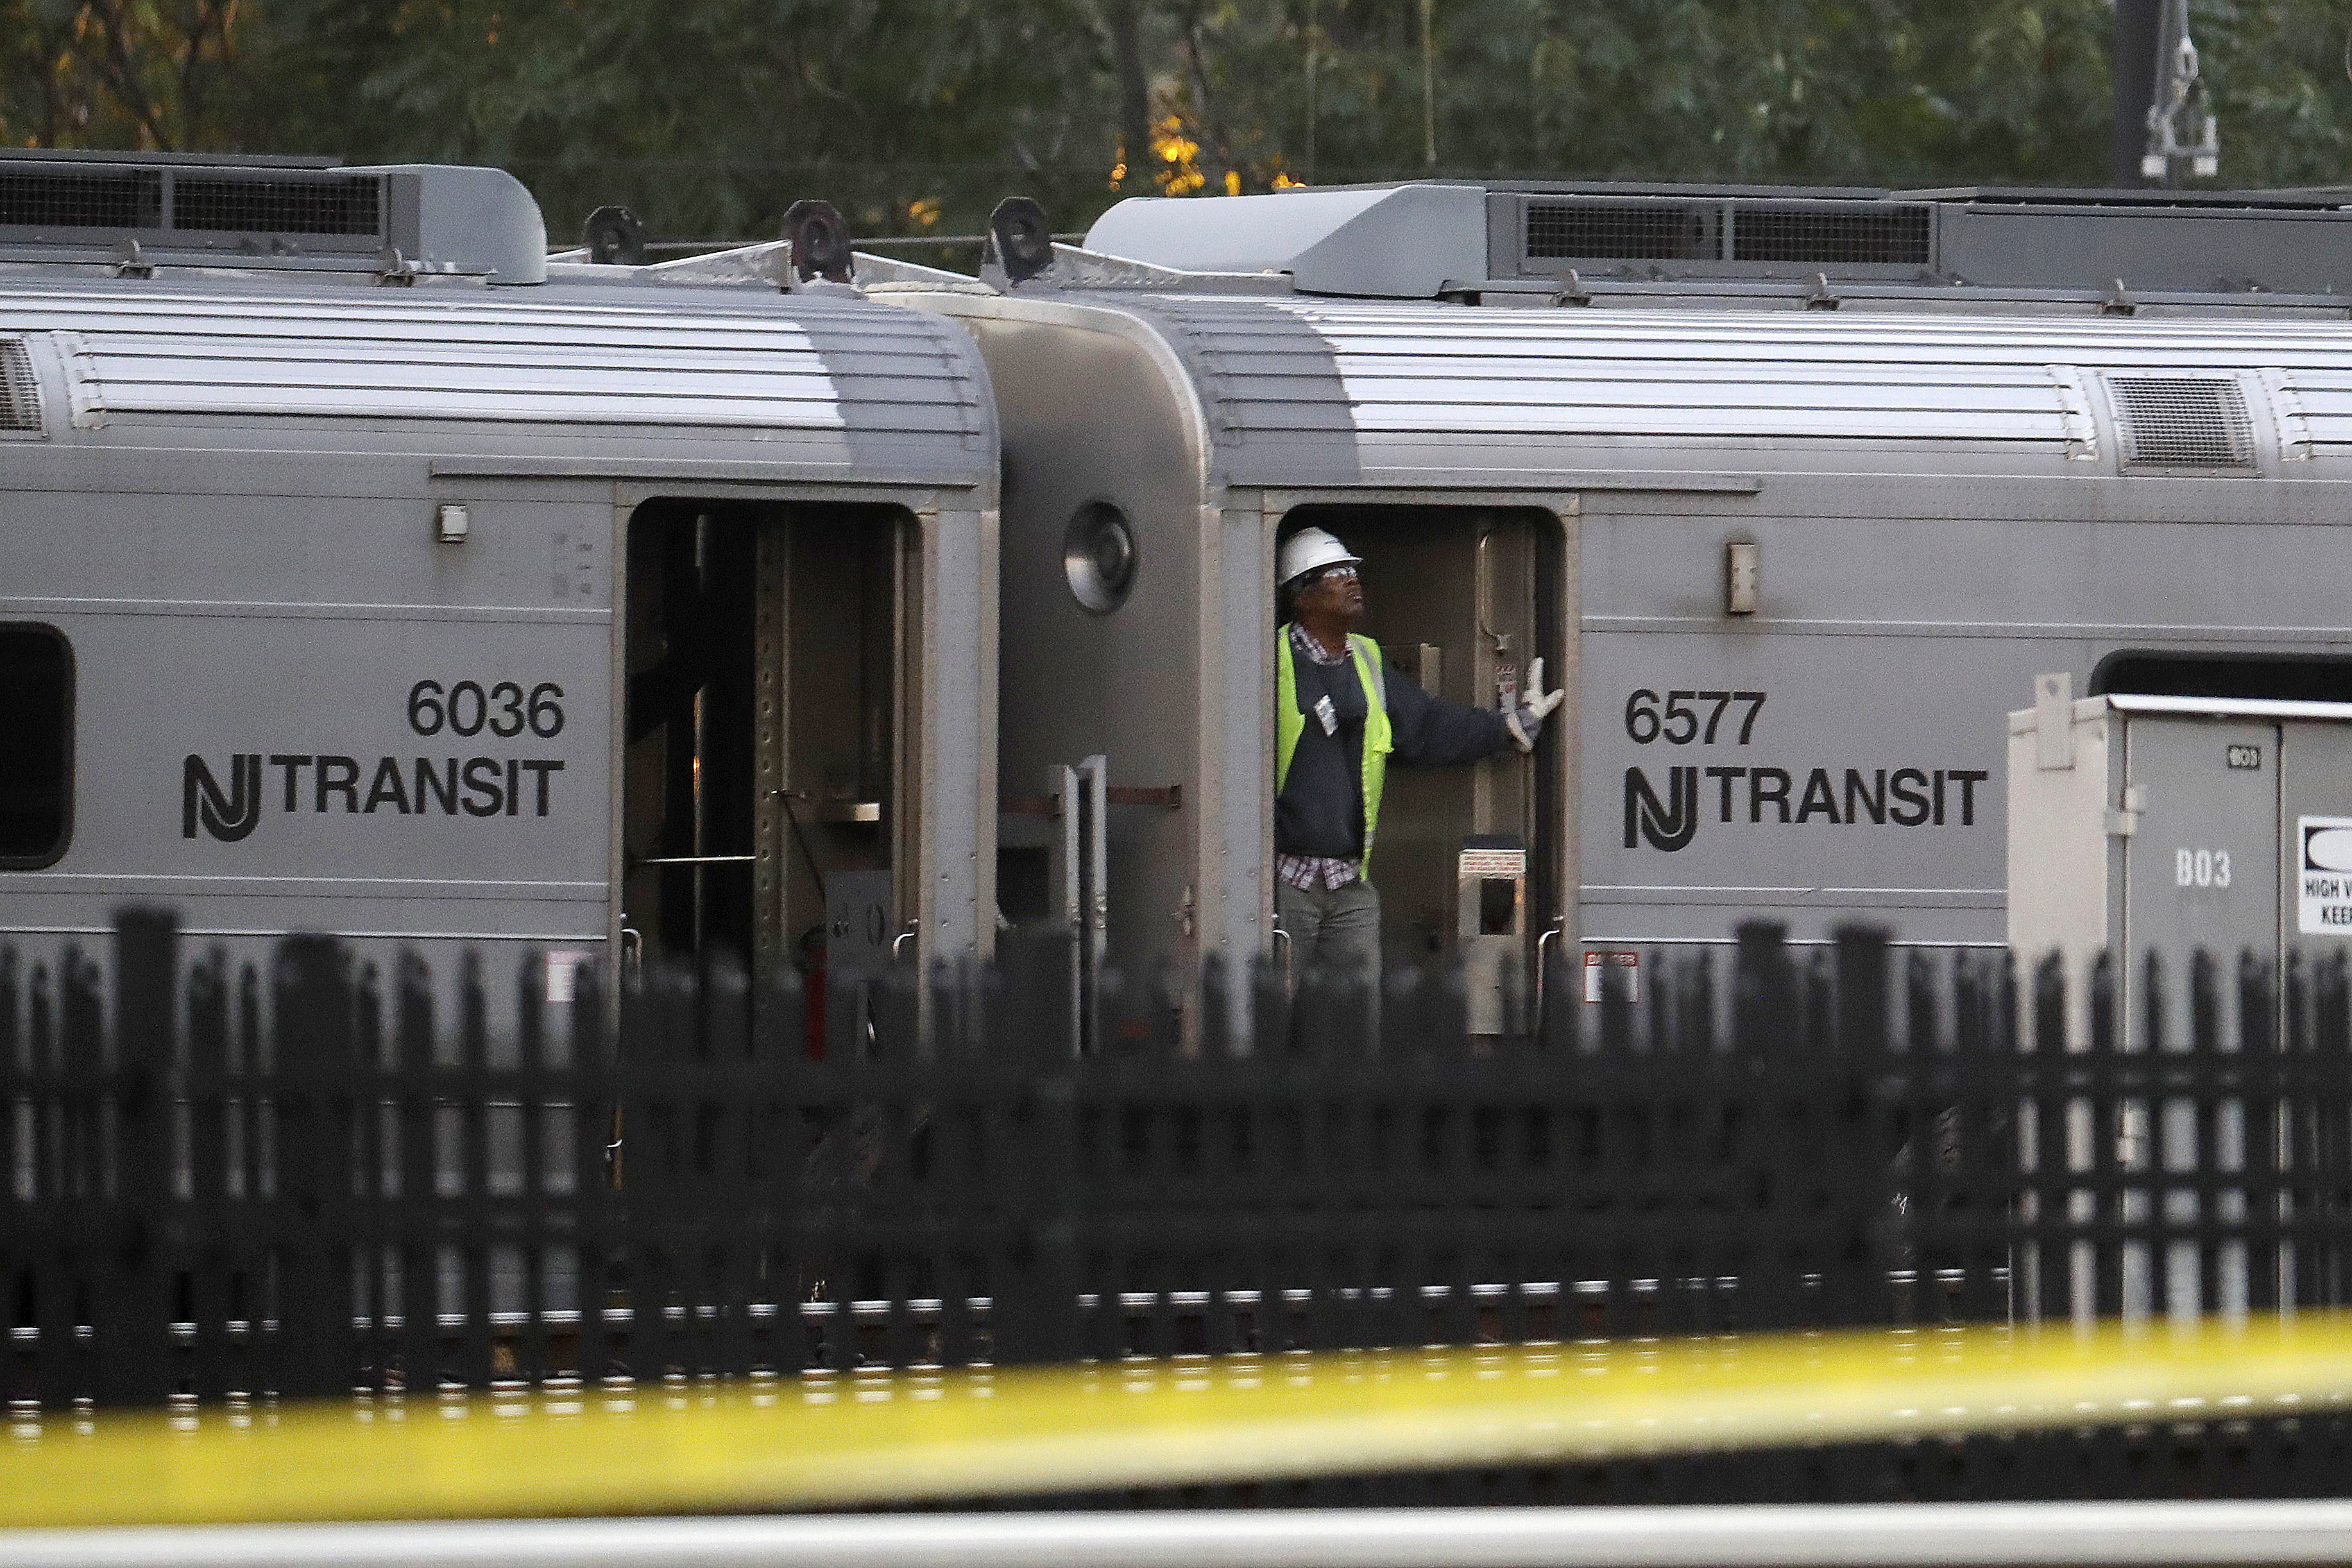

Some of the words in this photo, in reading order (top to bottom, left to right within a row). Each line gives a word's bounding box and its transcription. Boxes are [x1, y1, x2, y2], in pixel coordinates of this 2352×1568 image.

[407, 679, 565, 738] 6036
[1625, 688, 1767, 745] 6577
[268, 754, 566, 817] TRANSIT
[1705, 766, 1989, 827] TRANSIT
[2176, 848, 2232, 887] B03
[2305, 879, 2339, 898] HIGH
